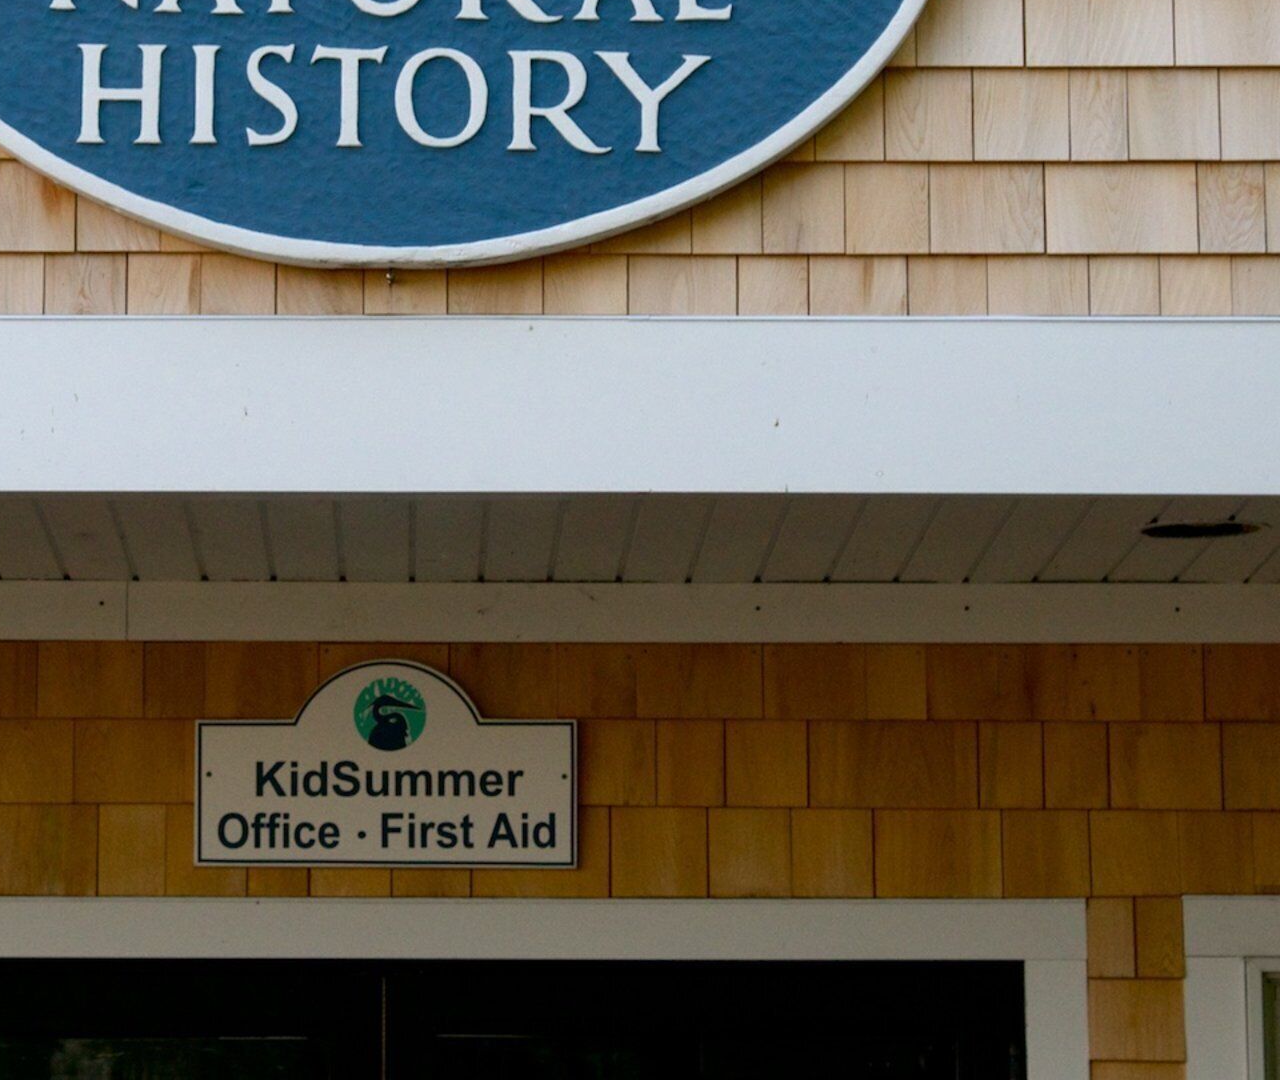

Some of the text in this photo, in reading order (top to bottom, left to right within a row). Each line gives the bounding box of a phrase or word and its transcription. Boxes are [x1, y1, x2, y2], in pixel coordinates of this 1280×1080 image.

[76, 43, 712, 154] HISTORY
[255, 759, 525, 798] KidSummer
[217, 812, 341, 850] Office
[381, 812, 475, 849] First
[487, 812, 557, 849] Aid
